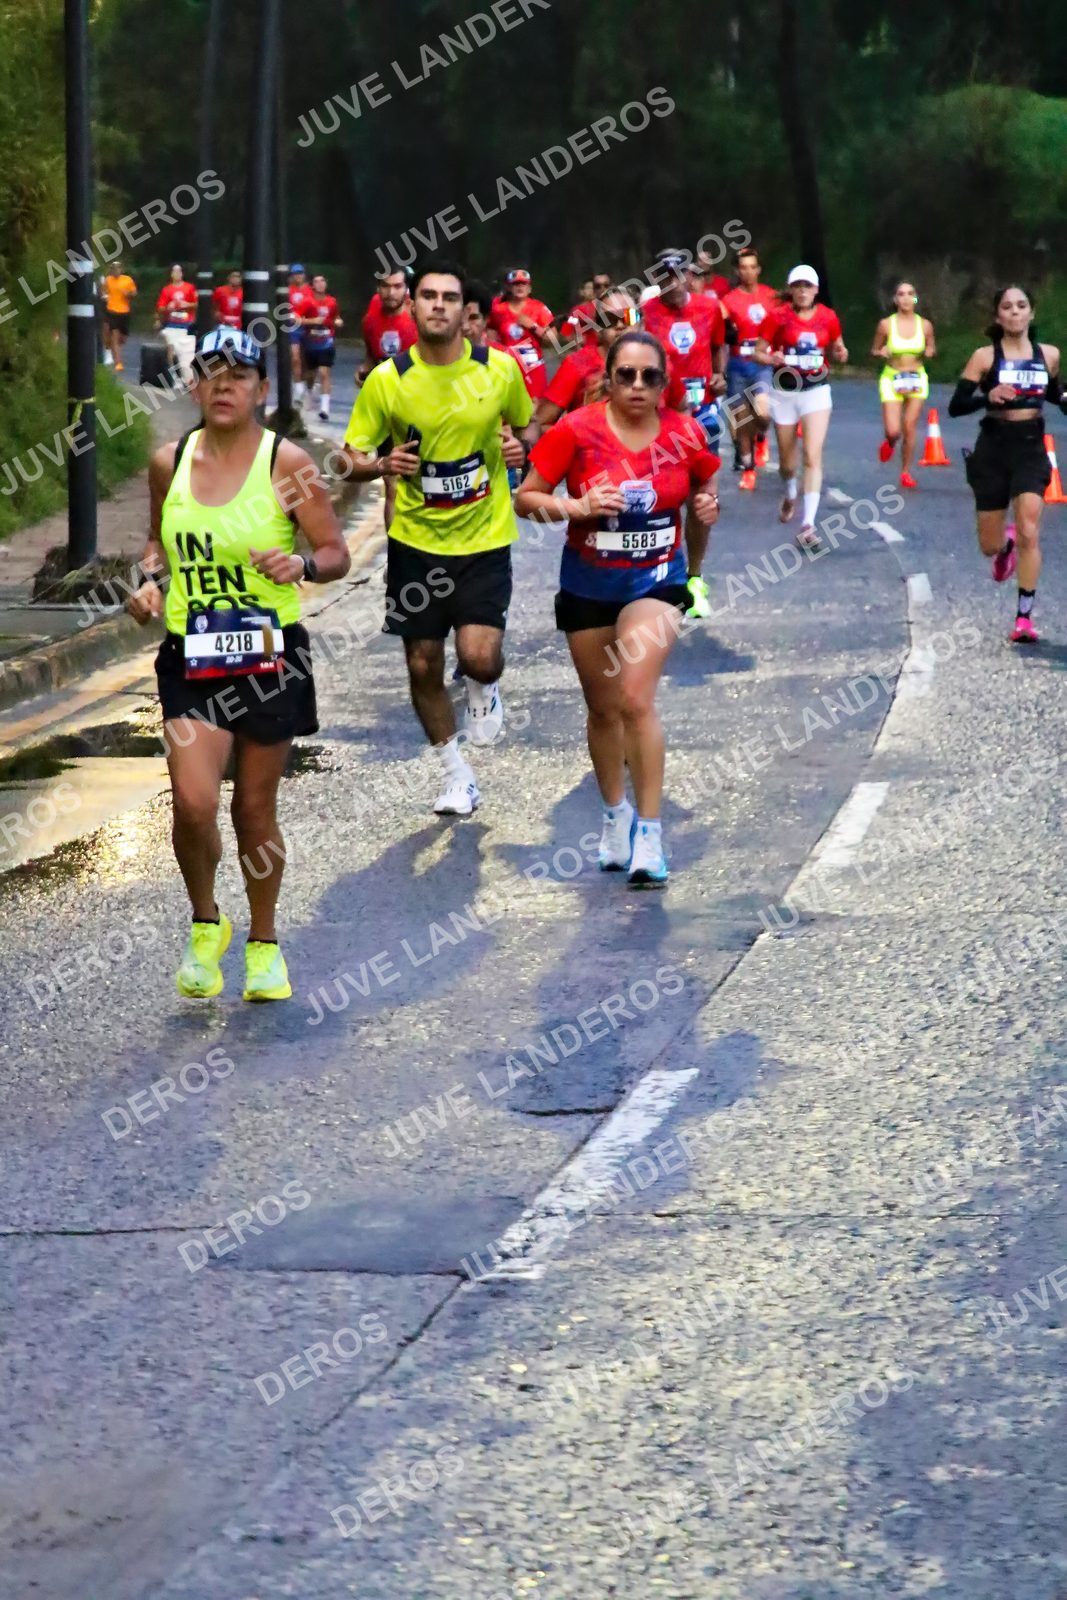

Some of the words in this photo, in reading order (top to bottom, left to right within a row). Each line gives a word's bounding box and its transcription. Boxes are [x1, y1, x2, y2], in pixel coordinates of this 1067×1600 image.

[441, 474, 471, 492] 5162
[175, 531, 213, 563] IN
[622, 531, 657, 549] 5583
[179, 564, 247, 596] TEN
[214, 632, 254, 653] 4218
